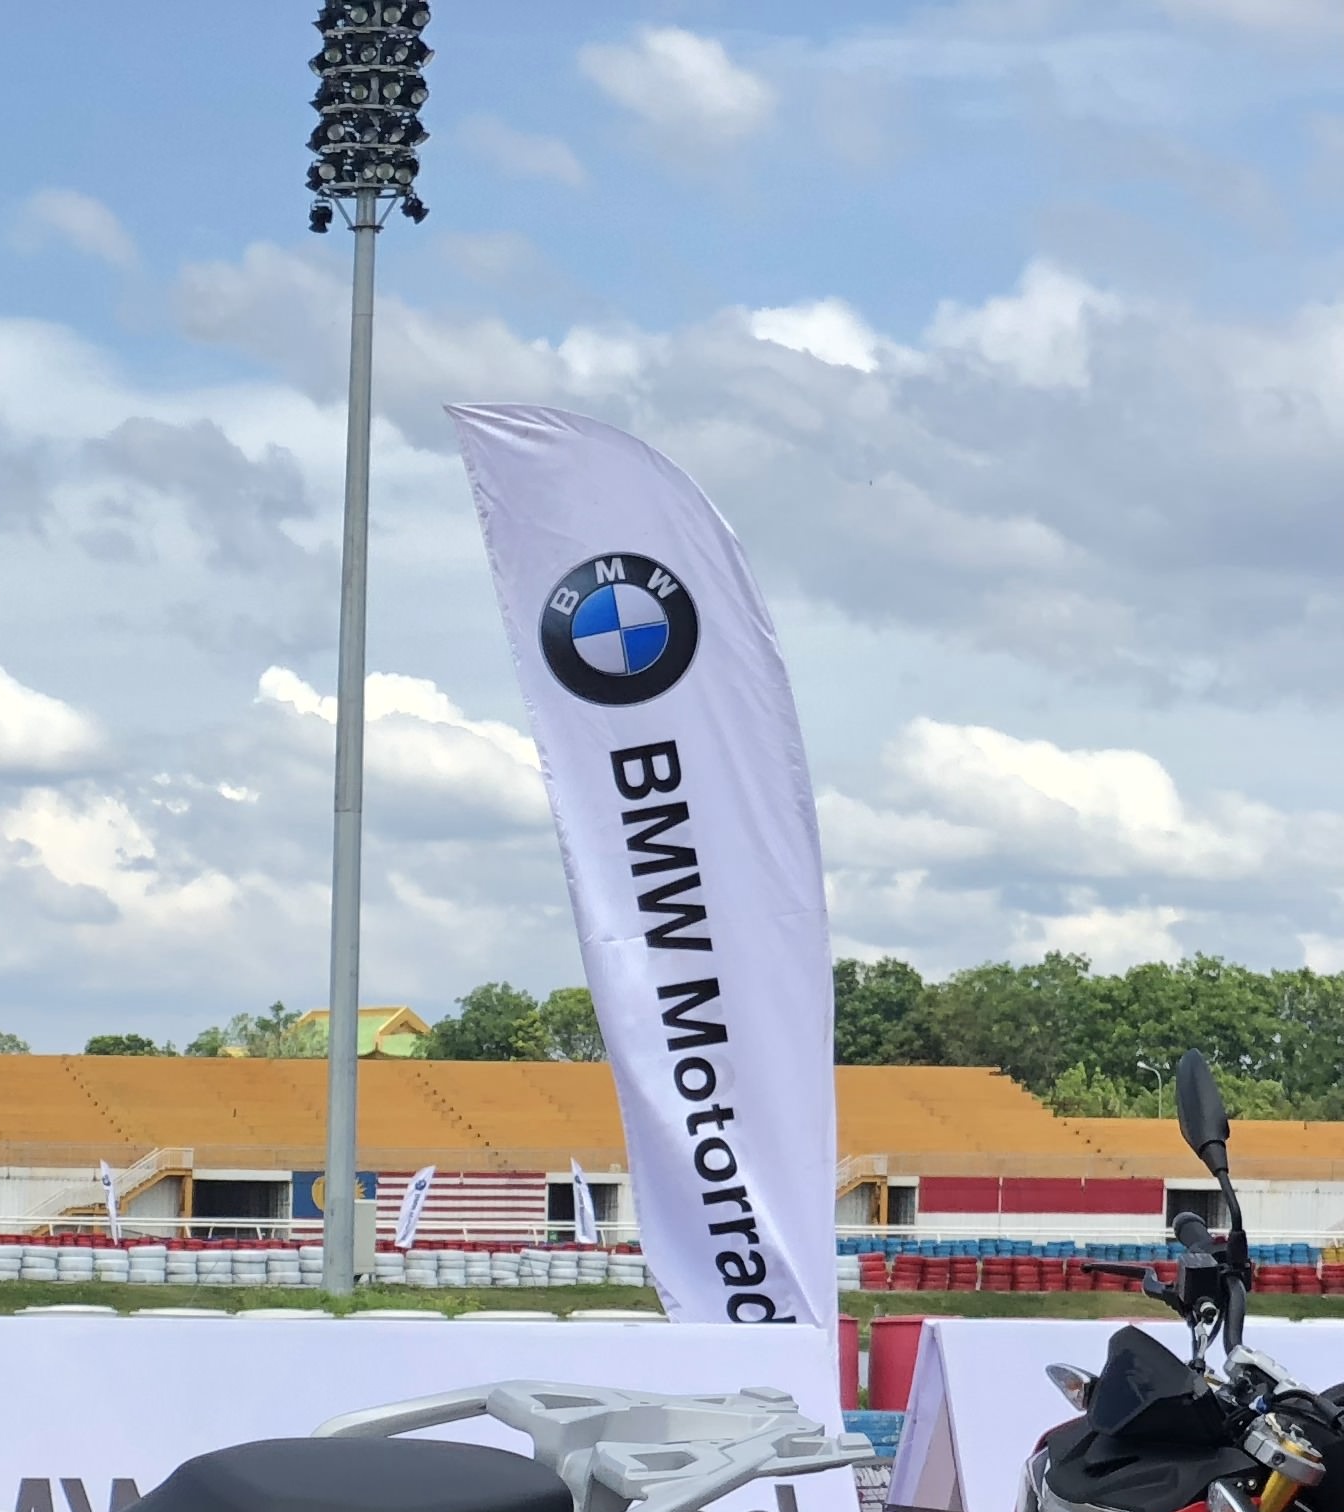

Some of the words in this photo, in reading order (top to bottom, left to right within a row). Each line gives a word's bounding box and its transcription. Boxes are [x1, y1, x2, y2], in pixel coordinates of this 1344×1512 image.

[549, 555, 679, 617] BMW
[609, 739, 713, 953] BMW
[657, 976, 797, 1324] Motorrad
